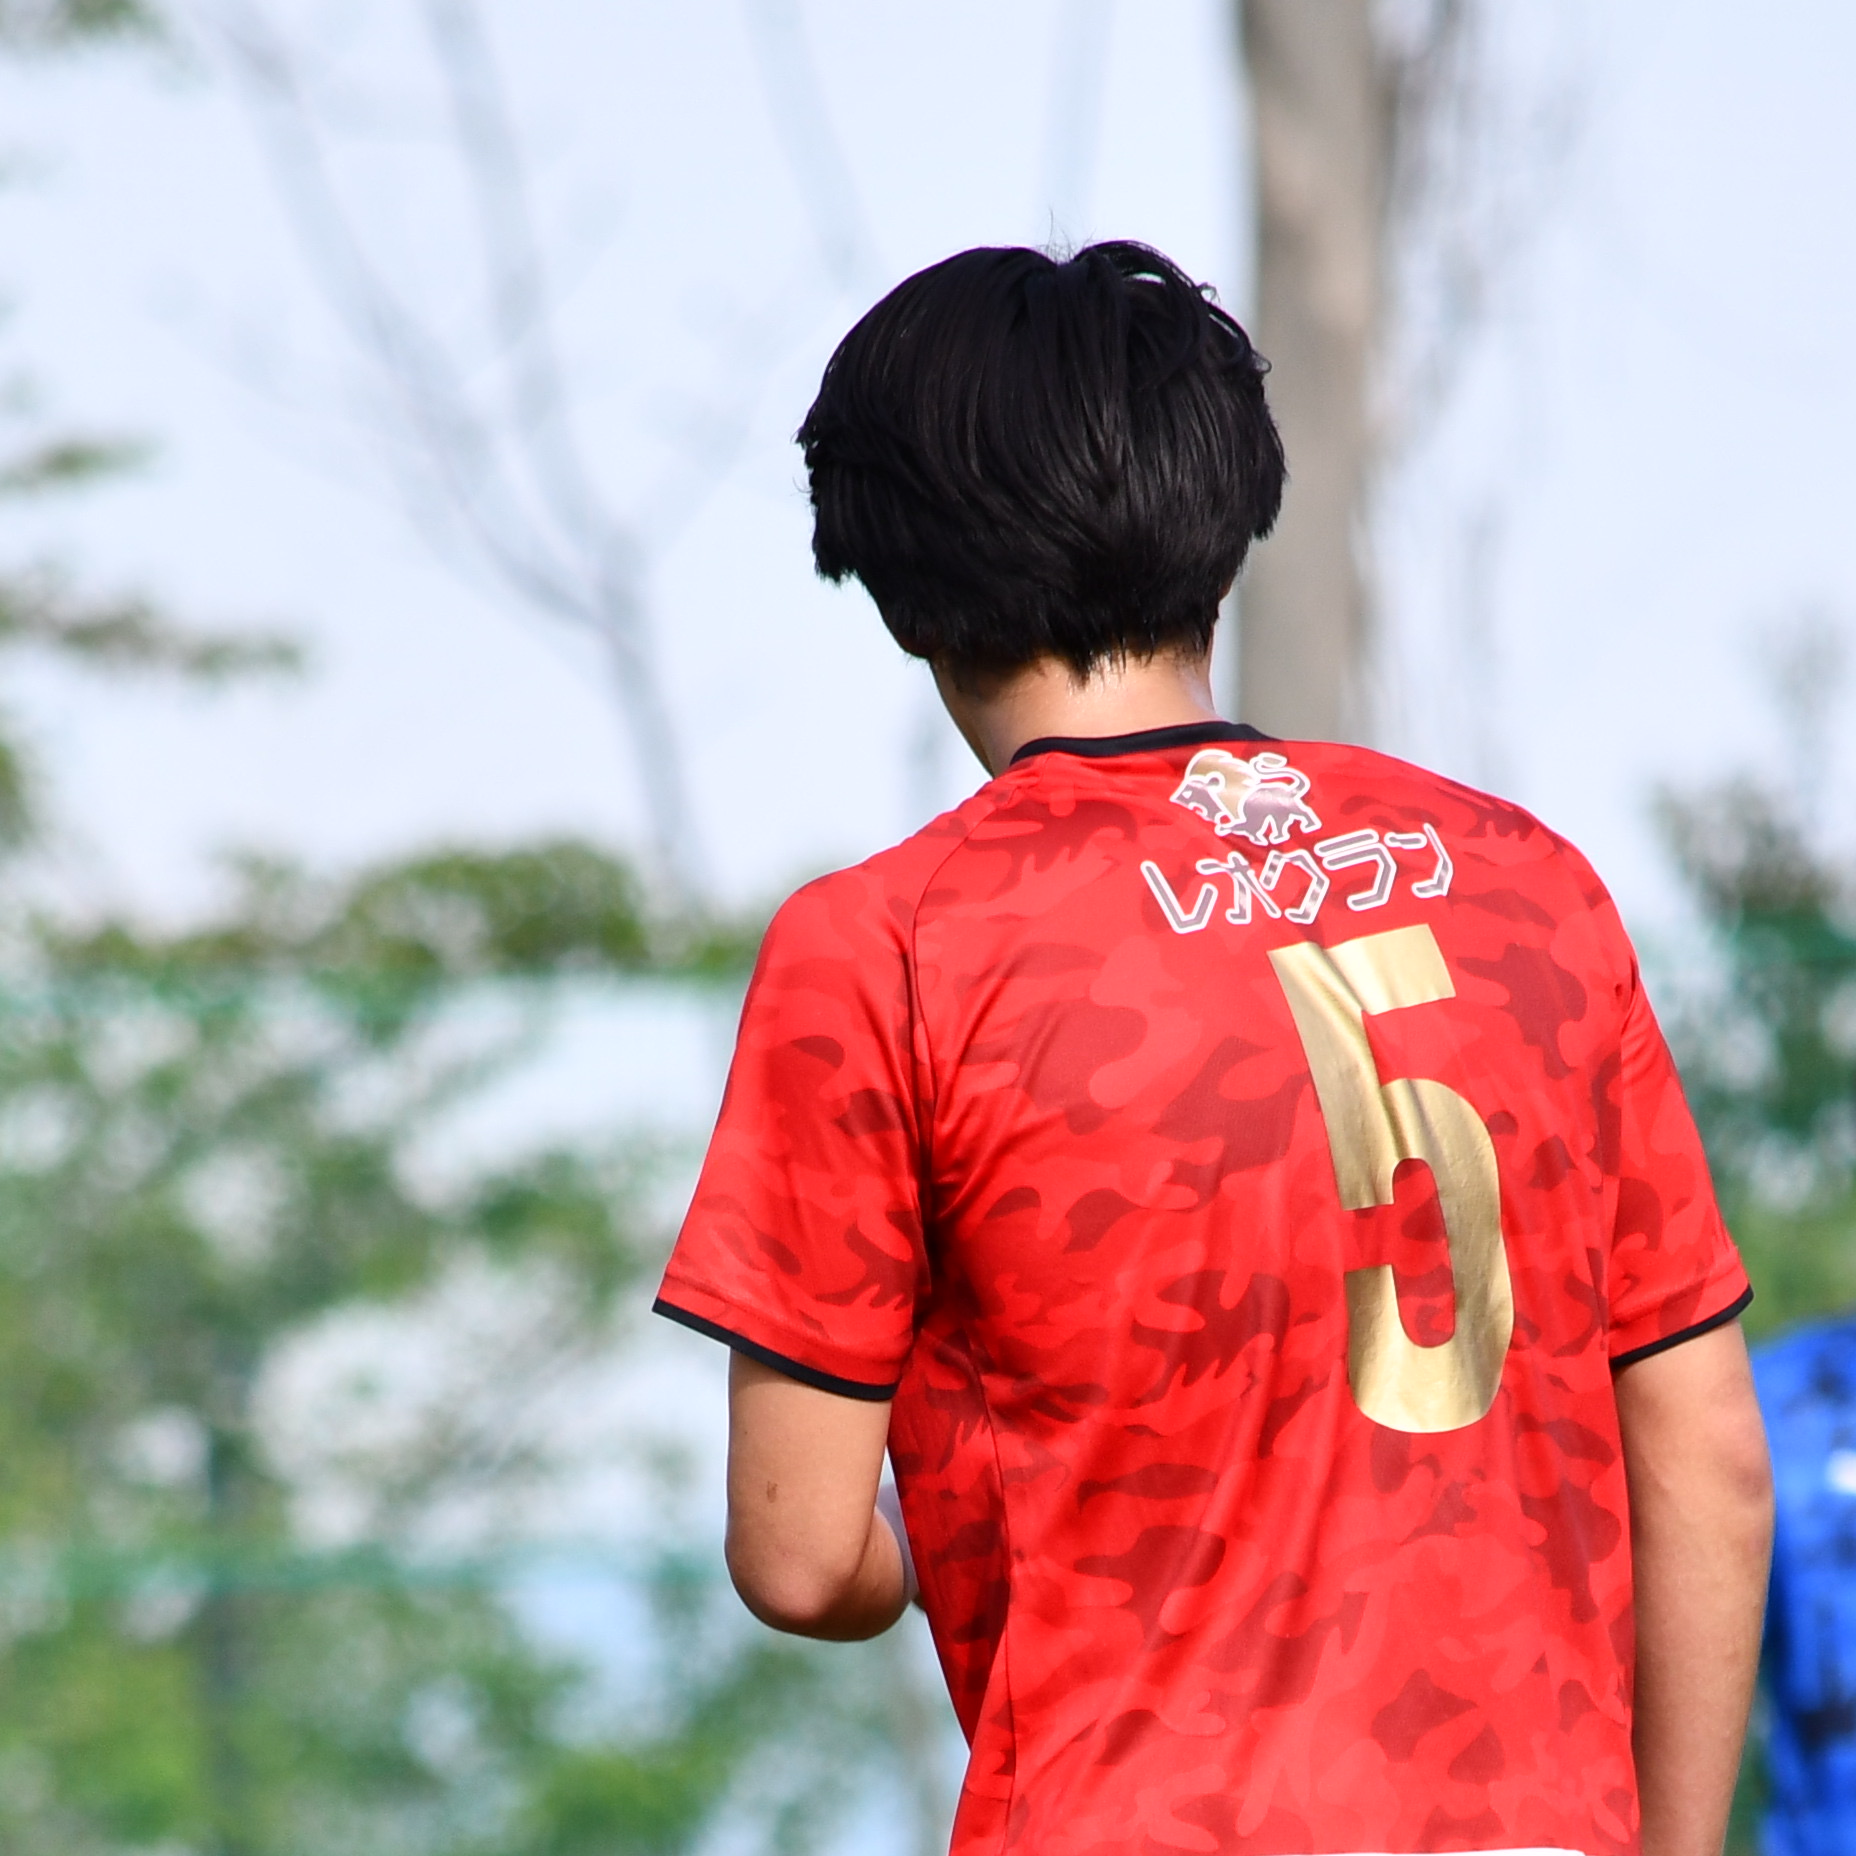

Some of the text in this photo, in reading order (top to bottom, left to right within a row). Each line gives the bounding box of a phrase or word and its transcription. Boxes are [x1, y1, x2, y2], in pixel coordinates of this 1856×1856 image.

[1140, 823, 1454, 934] レオクラン
[1267, 923, 1515, 1433] 5
